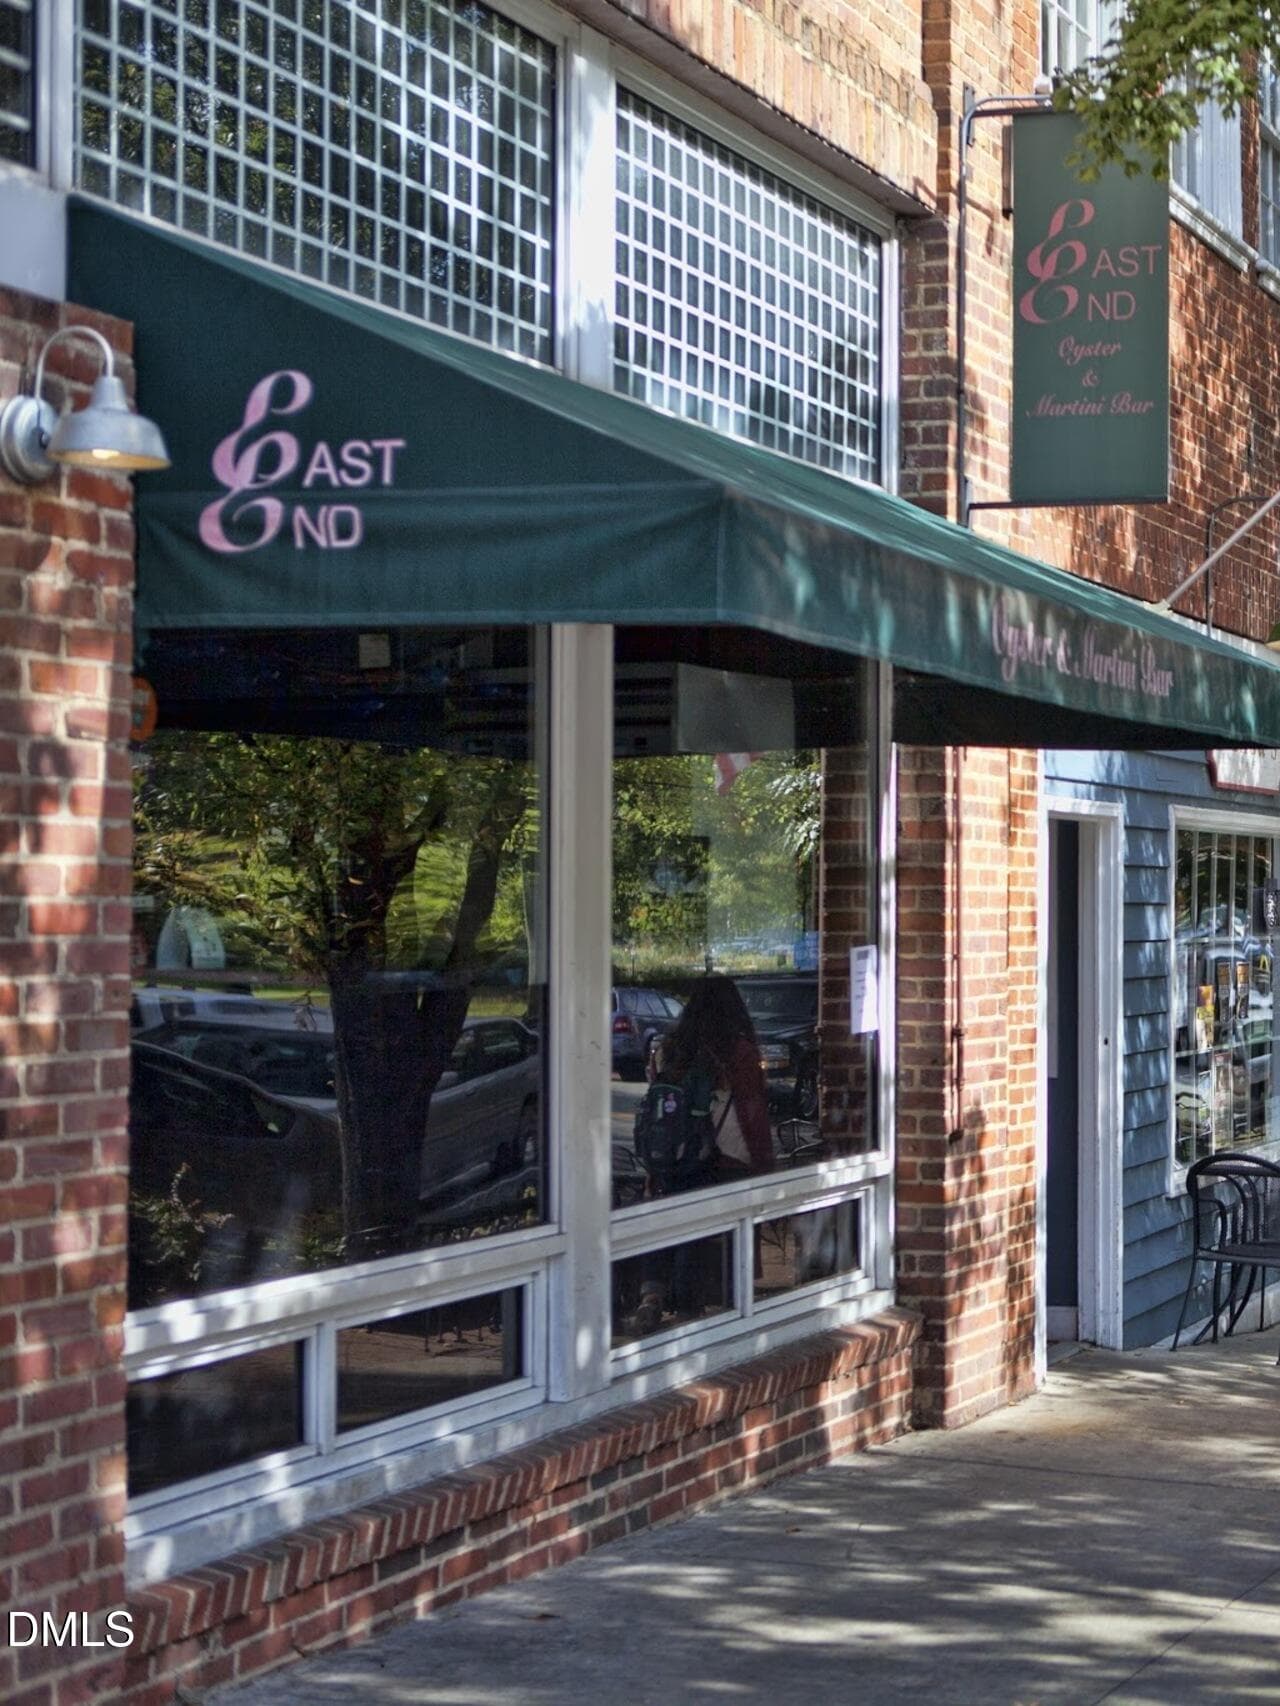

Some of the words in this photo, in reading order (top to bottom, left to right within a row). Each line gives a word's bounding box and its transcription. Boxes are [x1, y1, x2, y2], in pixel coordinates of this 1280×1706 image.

[1027, 200, 1162, 280] EAST
[1019, 254, 1137, 325] END
[1058, 335, 1122, 367] Oyster
[1082, 369, 1099, 388] &
[212, 369, 406, 488] EAST
[1026, 393, 1106, 417] Martini
[1110, 391, 1154, 416] Bar
[199, 454, 363, 553] END
[991, 592, 1053, 683] Oyster
[1056, 628, 1072, 675] &
[1074, 623, 1137, 691] Martini
[1140, 640, 1174, 697] Bar
